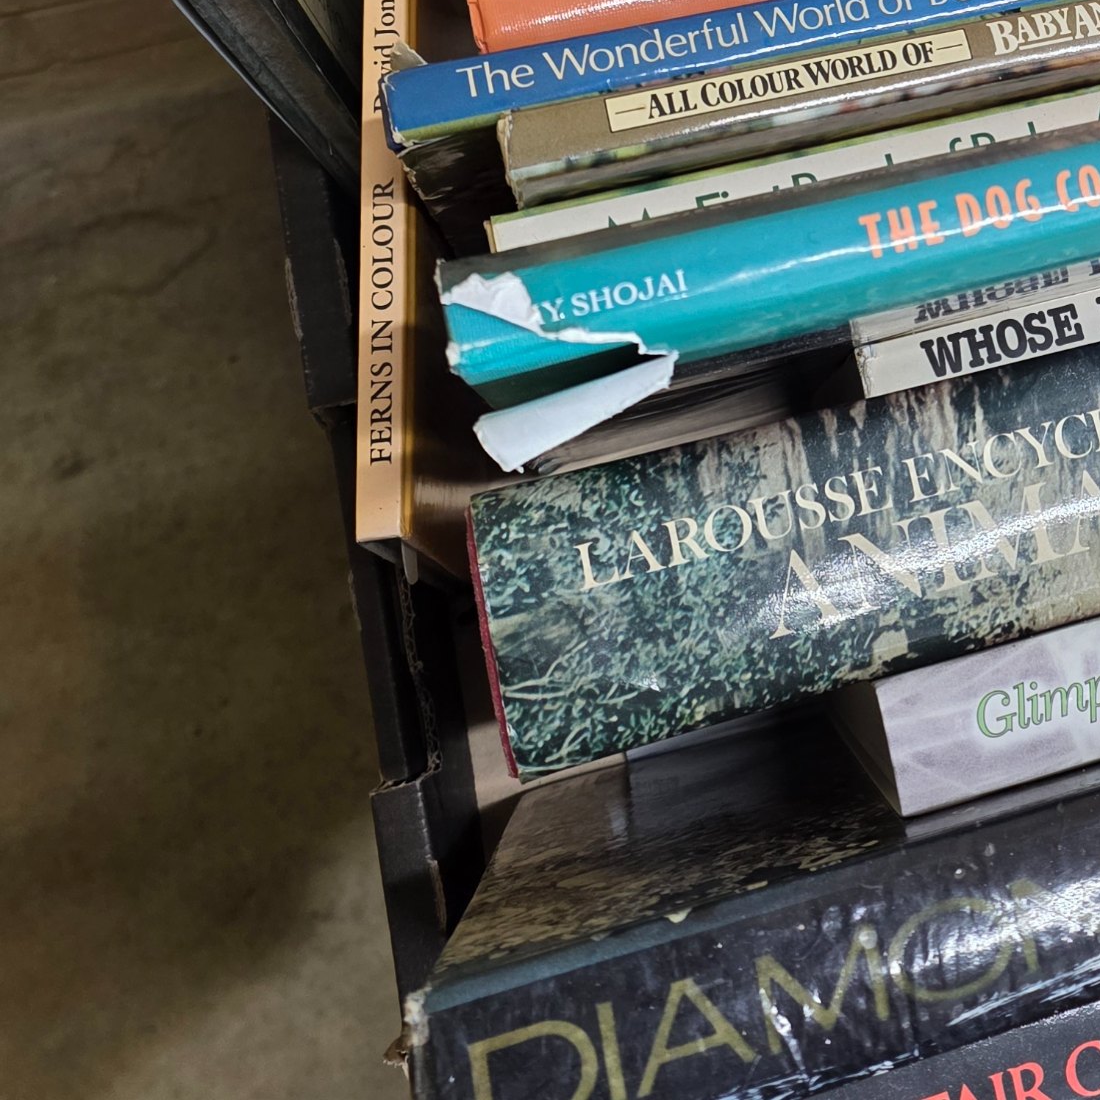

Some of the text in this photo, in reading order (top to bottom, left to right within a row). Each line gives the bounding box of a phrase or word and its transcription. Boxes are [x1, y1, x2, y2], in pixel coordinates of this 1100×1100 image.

[455, 63, 535, 98] The
[541, 11, 750, 81] Wonderful
[647, 42, 934, 119] ALL COLOUR WORLD OF
[860, 201, 945, 258] THE
[955, 179, 1043, 238] DOG
[369, 177, 395, 467] FERNS IN COLOUR
[570, 268, 689, 317] SHOJAI
[920, 303, 1086, 378] WHOSE
[574, 466, 894, 594] LAROUSSE
